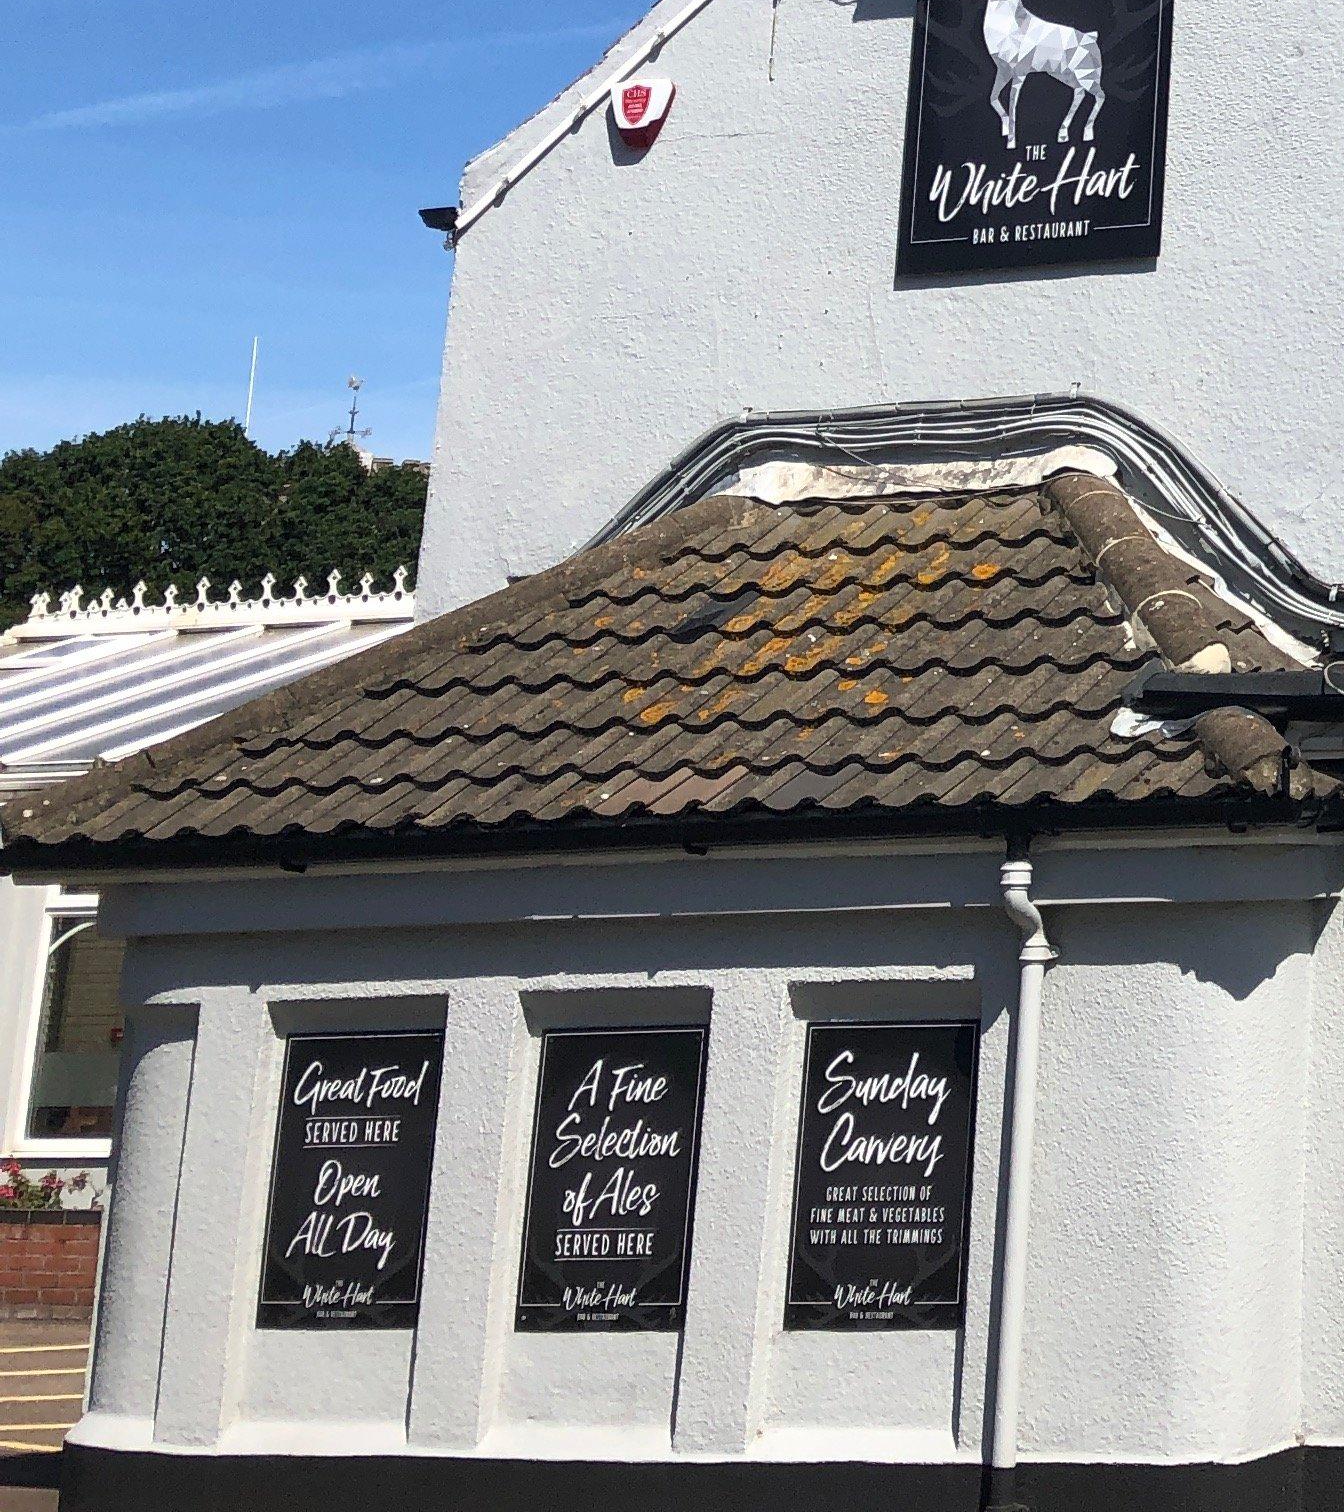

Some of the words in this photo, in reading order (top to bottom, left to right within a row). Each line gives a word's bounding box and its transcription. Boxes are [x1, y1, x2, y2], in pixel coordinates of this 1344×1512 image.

[1026, 145, 1047, 161] THE
[929, 162, 1040, 222] White
[1041, 146, 1140, 215] Hart
[972, 228, 994, 244] BAR
[1000, 226, 1009, 242] &
[1015, 220, 1090, 241] RESTAURANT
[294, 1060, 367, 1115] Great
[366, 1060, 429, 1108] Food
[568, 1059, 603, 1111] A
[609, 1063, 669, 1111] Fine
[817, 1050, 951, 1125] Sunday
[304, 1121, 358, 1143] SERVED
[364, 1120, 401, 1142] HERE
[549, 1113, 682, 1168] Selection
[820, 1112, 944, 1177] Carvery
[314, 1159, 381, 1206] Open
[563, 1172, 594, 1226] of
[589, 1167, 660, 1219] Ales
[826, 1186, 858, 1202] GREAT
[862, 1186, 916, 1202] SELECTION
[919, 1186, 933, 1201] OF
[810, 1208, 833, 1223] FINE
[837, 1207, 866, 1223] MEAT
[869, 1208, 878, 1223] &
[882, 1207, 945, 1223] VEGETABLES
[285, 1211, 337, 1259] All
[336, 1211, 397, 1270] Day
[555, 1233, 610, 1256] SERVED
[617, 1233, 655, 1255] HERE
[810, 1229, 837, 1245] WITH
[841, 1229, 858, 1244] ALL
[863, 1229, 881, 1244] THE
[887, 1229, 943, 1244] TRIMMINGS
[340, 1281, 374, 1308] Hart
[562, 1286, 602, 1310] White
[601, 1284, 637, 1310] Hart
[833, 1283, 876, 1309] White
[876, 1281, 913, 1309] Hart
